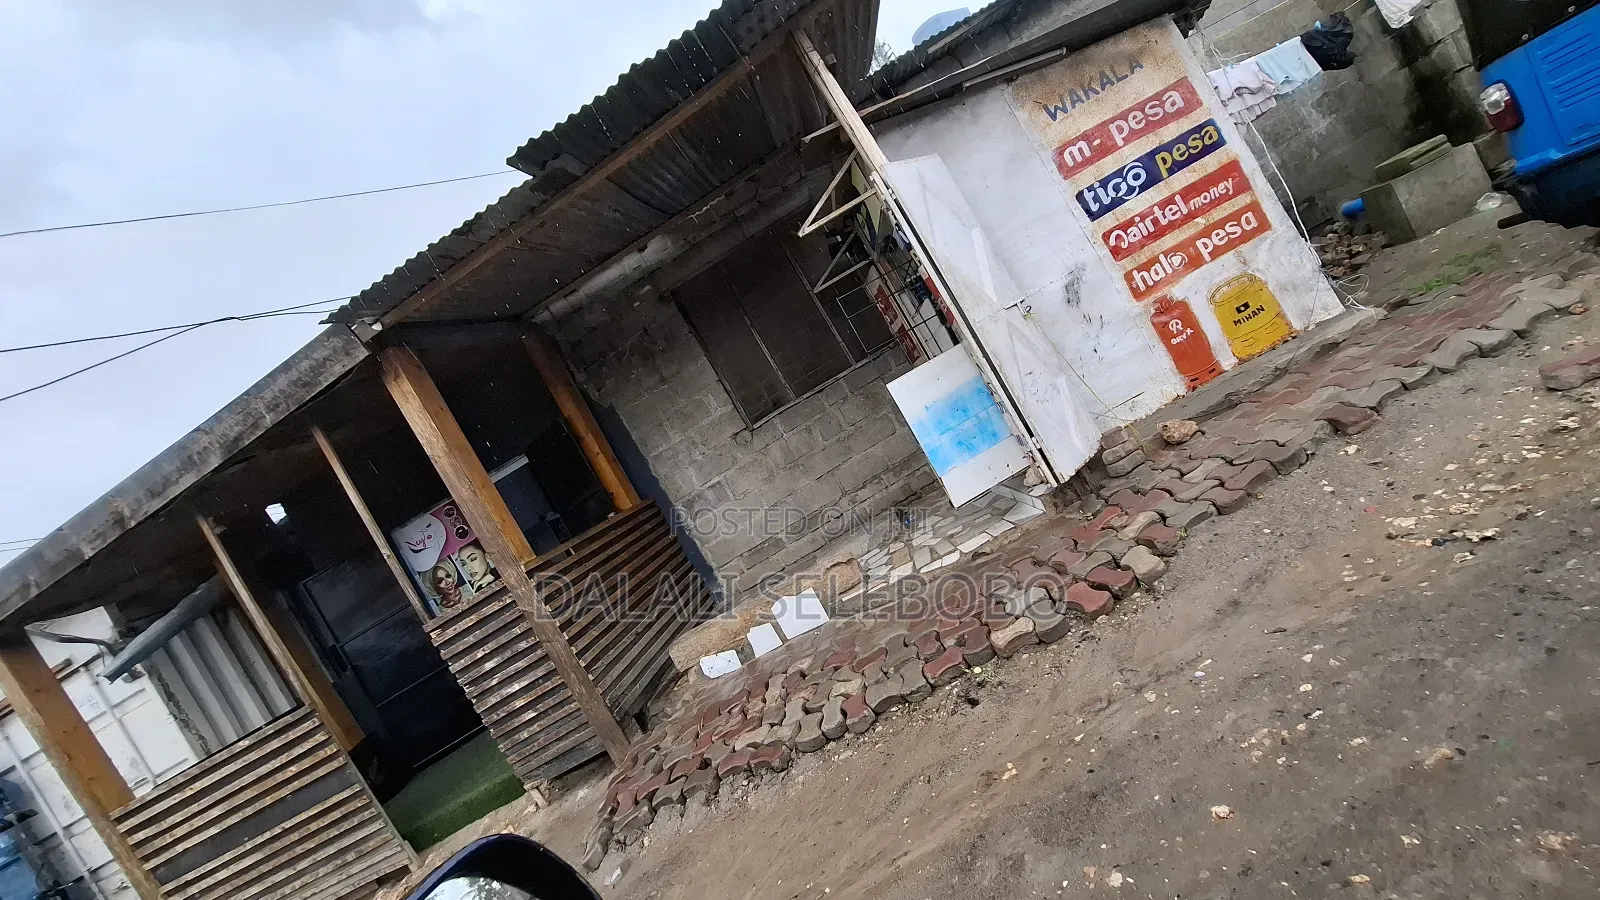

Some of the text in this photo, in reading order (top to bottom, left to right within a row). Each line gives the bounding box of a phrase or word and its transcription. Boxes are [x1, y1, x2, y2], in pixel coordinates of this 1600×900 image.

[1042, 54, 1144, 122] WAKALA
[1108, 88, 1184, 147] pesa
[1155, 125, 1219, 178] pesa
[1189, 178, 1233, 211] money
[1196, 211, 1259, 262] pesa
[1232, 304, 1265, 327] MIHAN
